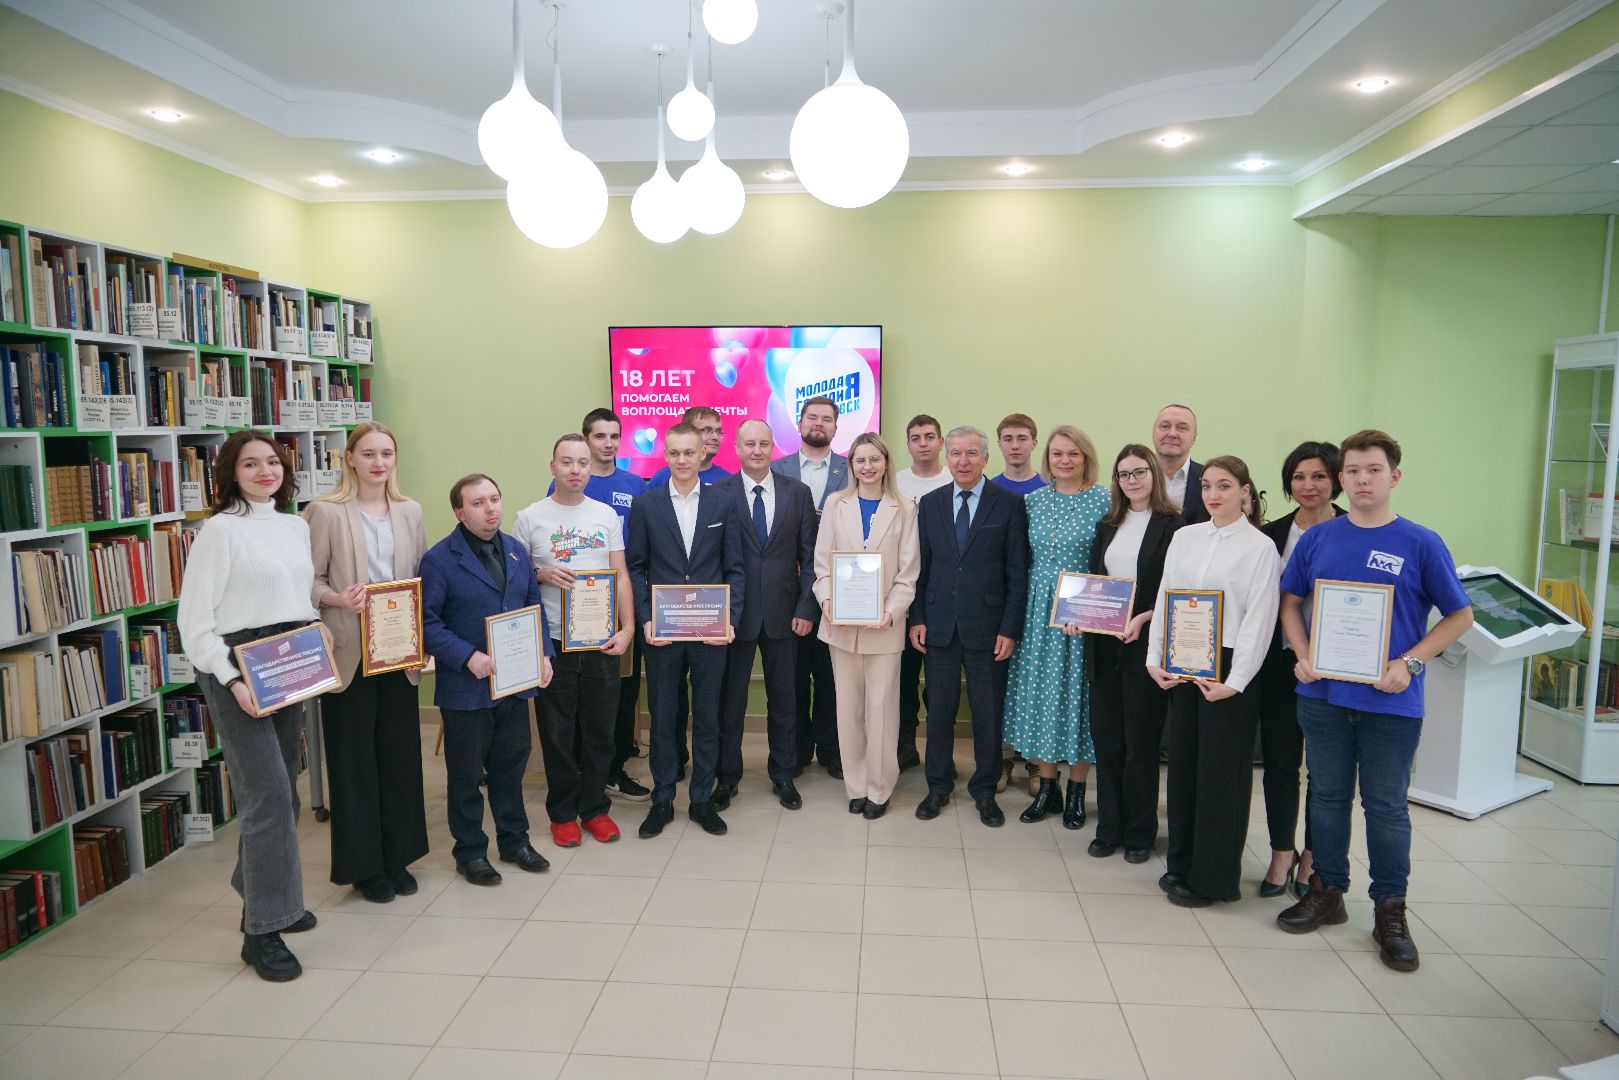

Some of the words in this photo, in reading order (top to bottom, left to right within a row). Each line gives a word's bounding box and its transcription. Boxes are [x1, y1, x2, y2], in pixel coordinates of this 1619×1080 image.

[620, 369, 643, 387] 18
[649, 369, 696, 387] ЛЕТ
[796, 371, 860, 400] МОЛОДАЯ
[621, 393, 690, 403] ПОМОГАЕМ
